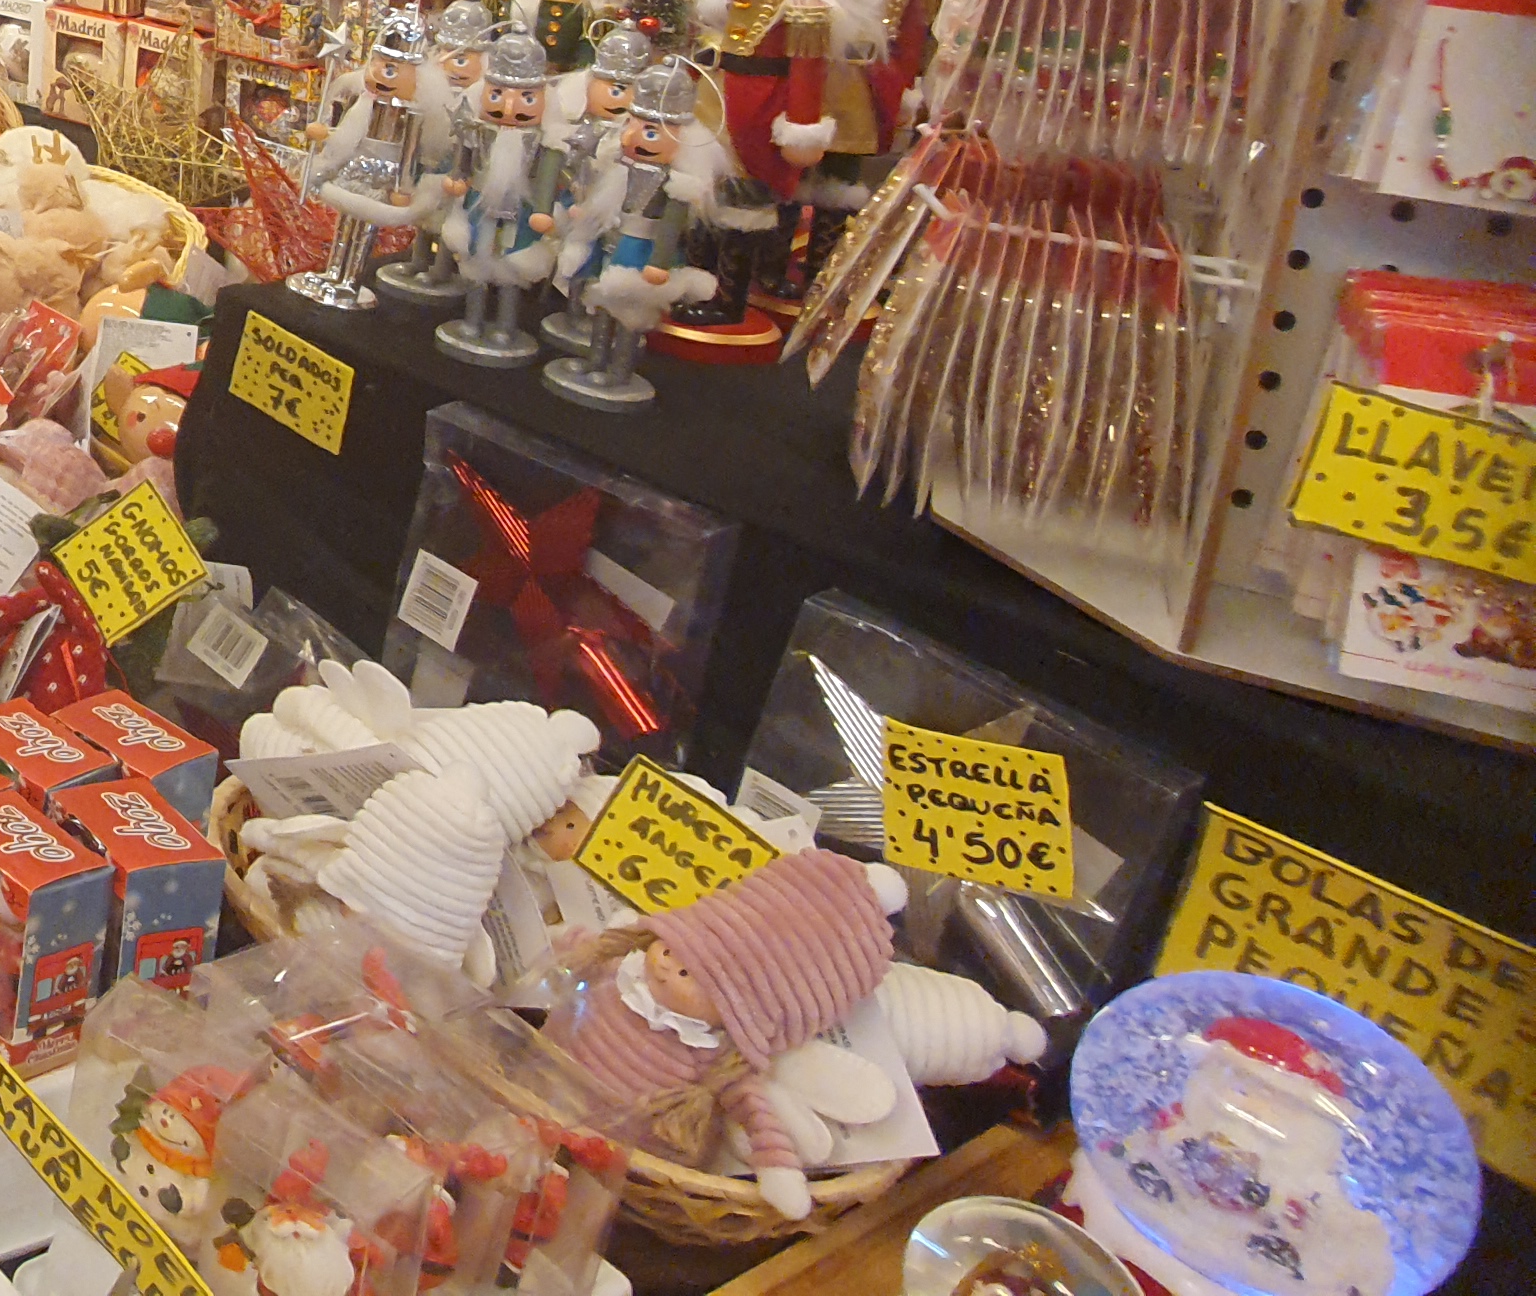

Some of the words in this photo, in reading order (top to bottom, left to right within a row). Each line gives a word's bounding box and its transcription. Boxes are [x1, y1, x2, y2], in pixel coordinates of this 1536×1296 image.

[56, 14, 107, 39] Madrid
[250, 326, 342, 393] SOLDADOS
[268, 383, 302, 419] 7€
[121, 501, 188, 587] GNOMOS
[1384, 485, 1534, 560] 3,5€
[76, 558, 111, 599] 5€
[887, 743, 1053, 796] ESTRELLA
[905, 782, 1062, 828] PEQUEÑA
[912, 818, 1056, 871] 4'50€
[617, 853, 678, 909] 6€
[1221, 827, 1428, 945] BOLAS
[1441, 932, 1530, 994] DE
